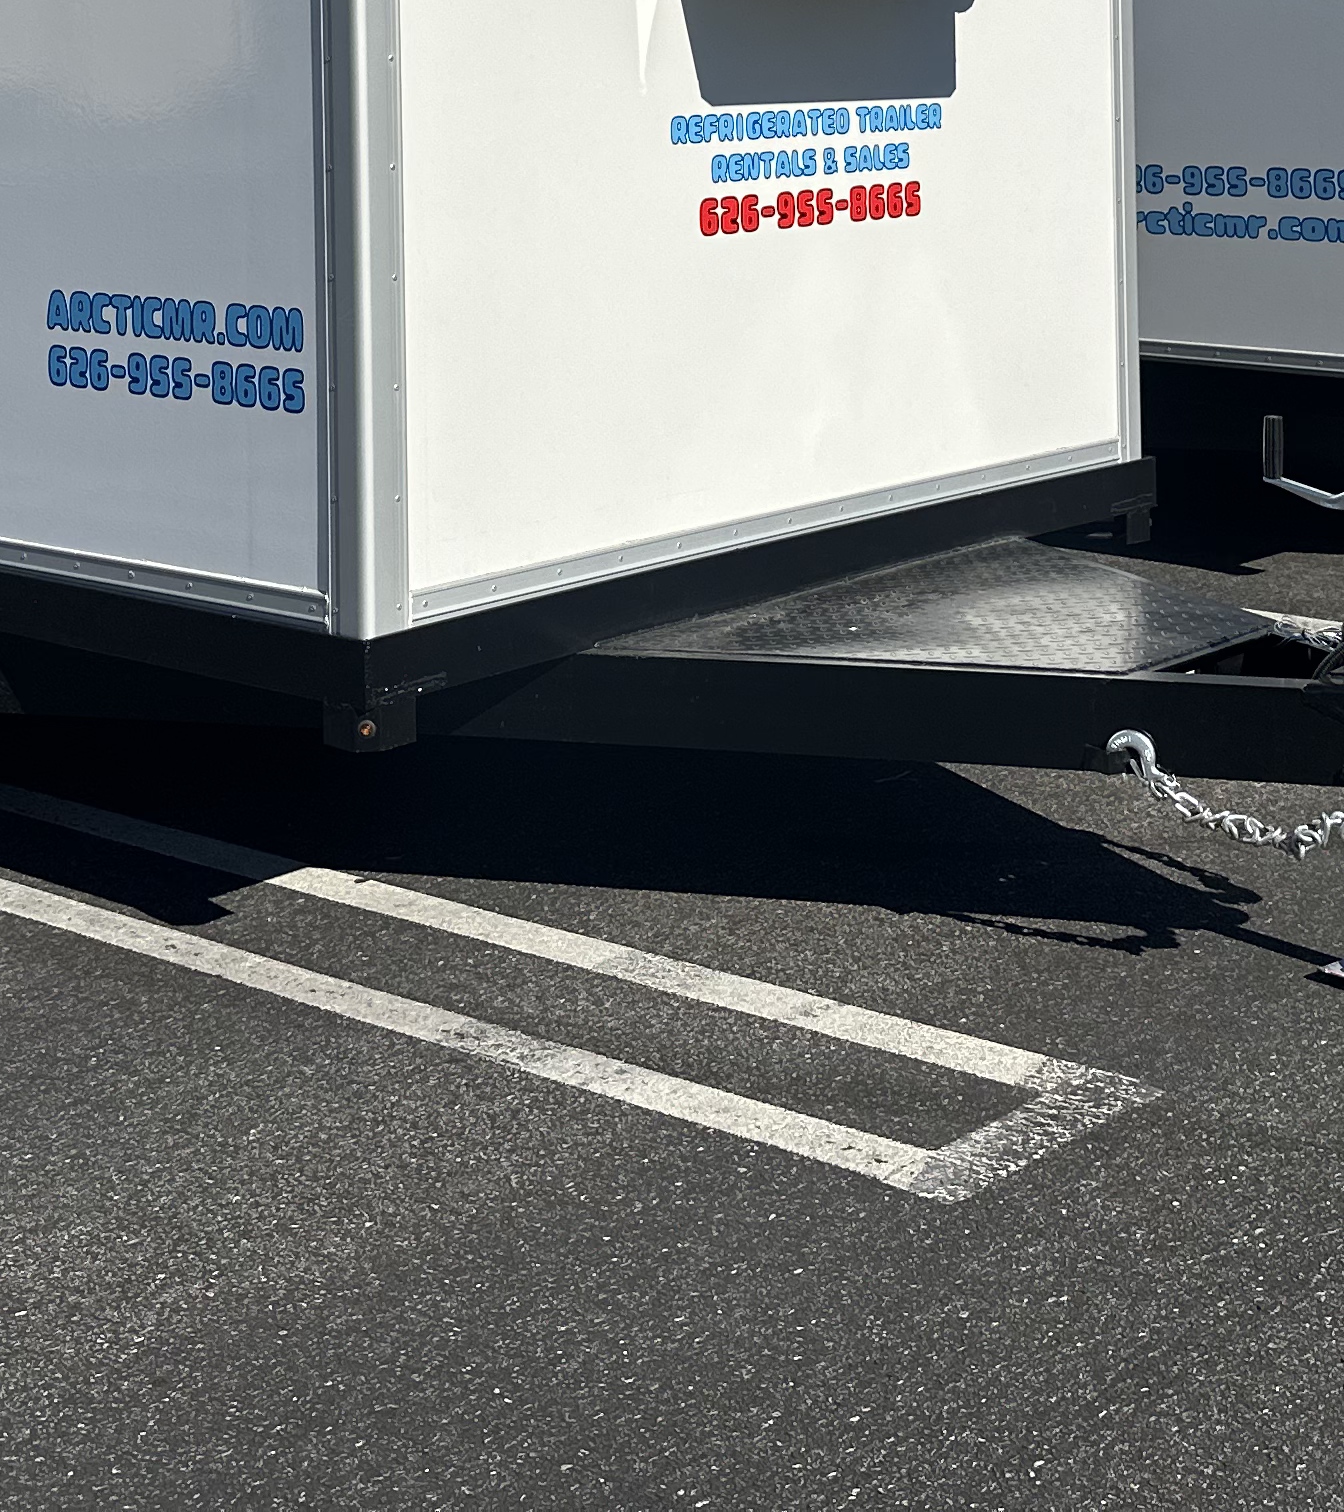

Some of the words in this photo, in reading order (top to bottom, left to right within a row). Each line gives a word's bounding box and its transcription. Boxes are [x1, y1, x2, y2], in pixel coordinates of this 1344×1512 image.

[670, 107, 850, 145] REFRIGERATED
[856, 103, 942, 134] TRAILER
[711, 148, 817, 183] RENTALS
[823, 147, 838, 175] &
[844, 143, 910, 173] SALES
[699, 181, 921, 236] 626-955-8665
[46, 289, 304, 353] ARCTICMR.COM
[48, 344, 305, 414] 626-955-8665
